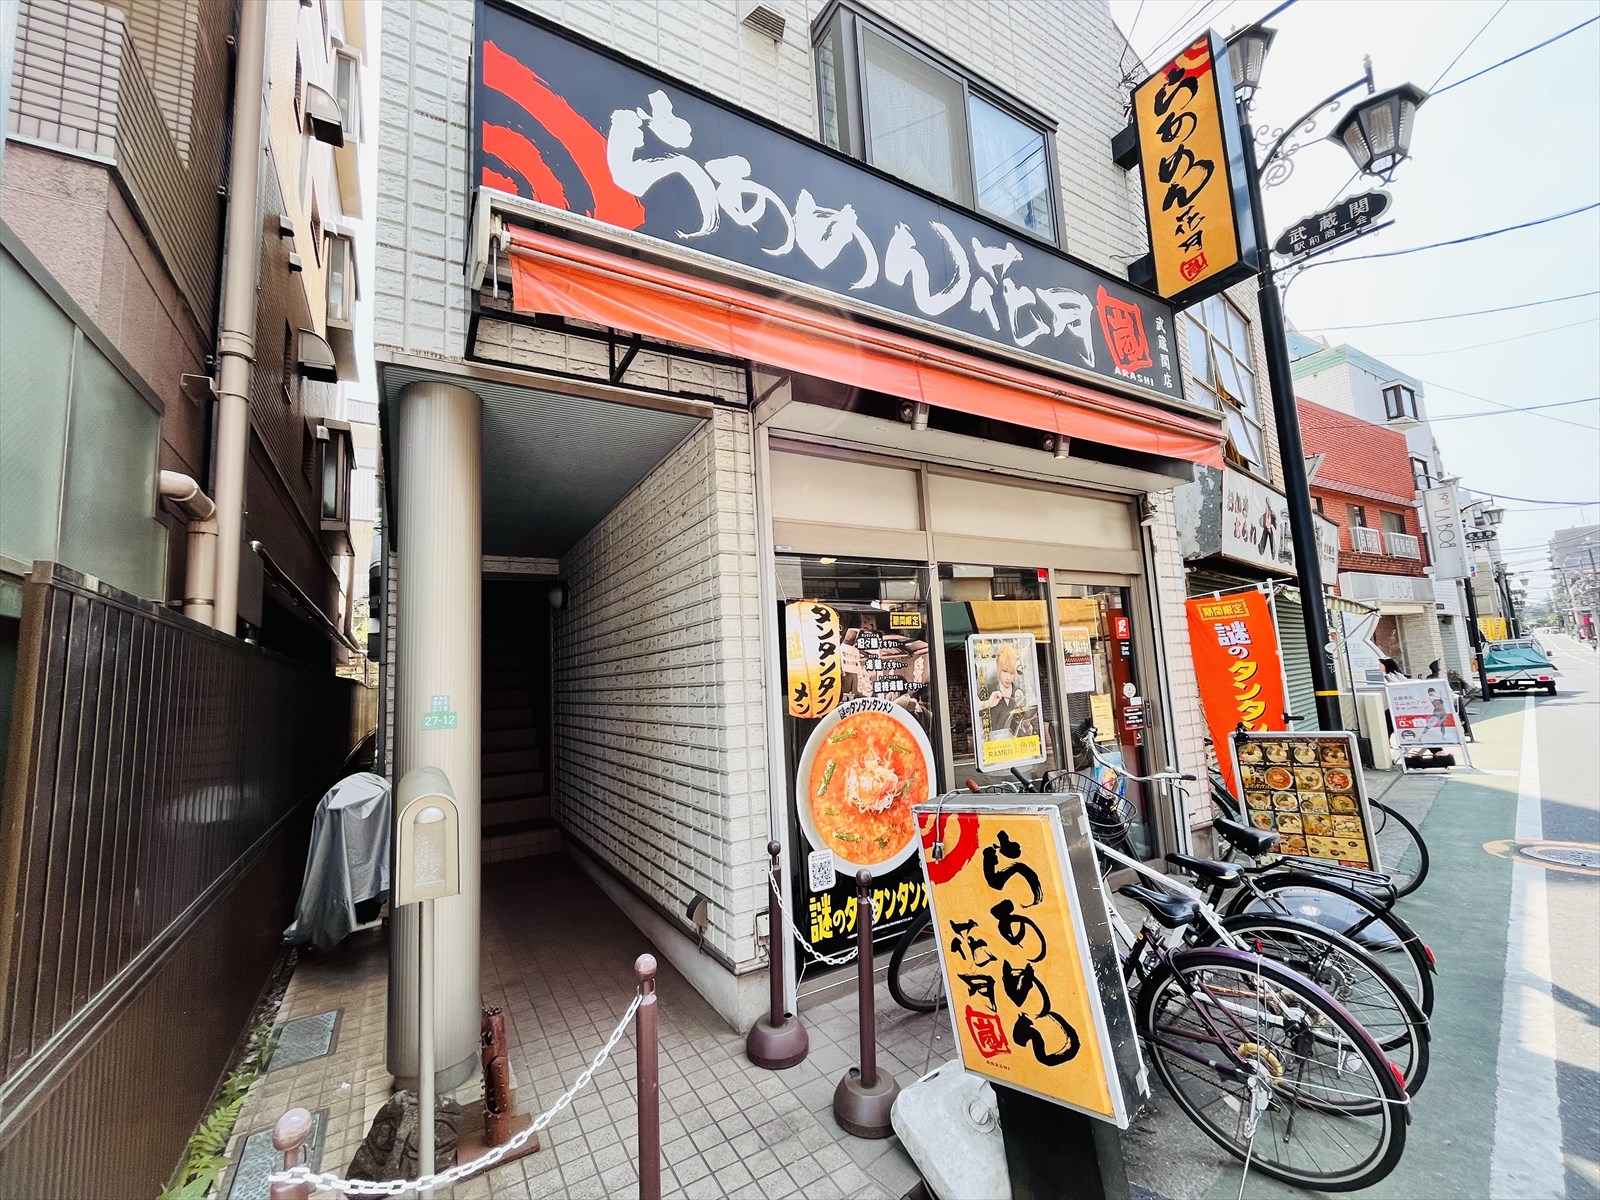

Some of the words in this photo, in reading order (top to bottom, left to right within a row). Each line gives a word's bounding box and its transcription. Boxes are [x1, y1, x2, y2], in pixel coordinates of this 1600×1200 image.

[1289, 197, 1369, 245] 武蔵関
[1293, 215, 1368, 252] 駅前商工会
[1155, 316, 1173, 389] 武蔵関店
[1114, 366, 1154, 387] ARASHI
[1203, 604, 1244, 617] 期間限定
[811, 605, 837, 715] タンタンタン
[793, 682, 810, 715] メン
[424, 715, 455, 726] 27-12
[950, 919, 998, 1013] 花月
[983, 830, 1081, 1067] らあめん
[986, 1060, 1011, 1071] ARASHI
